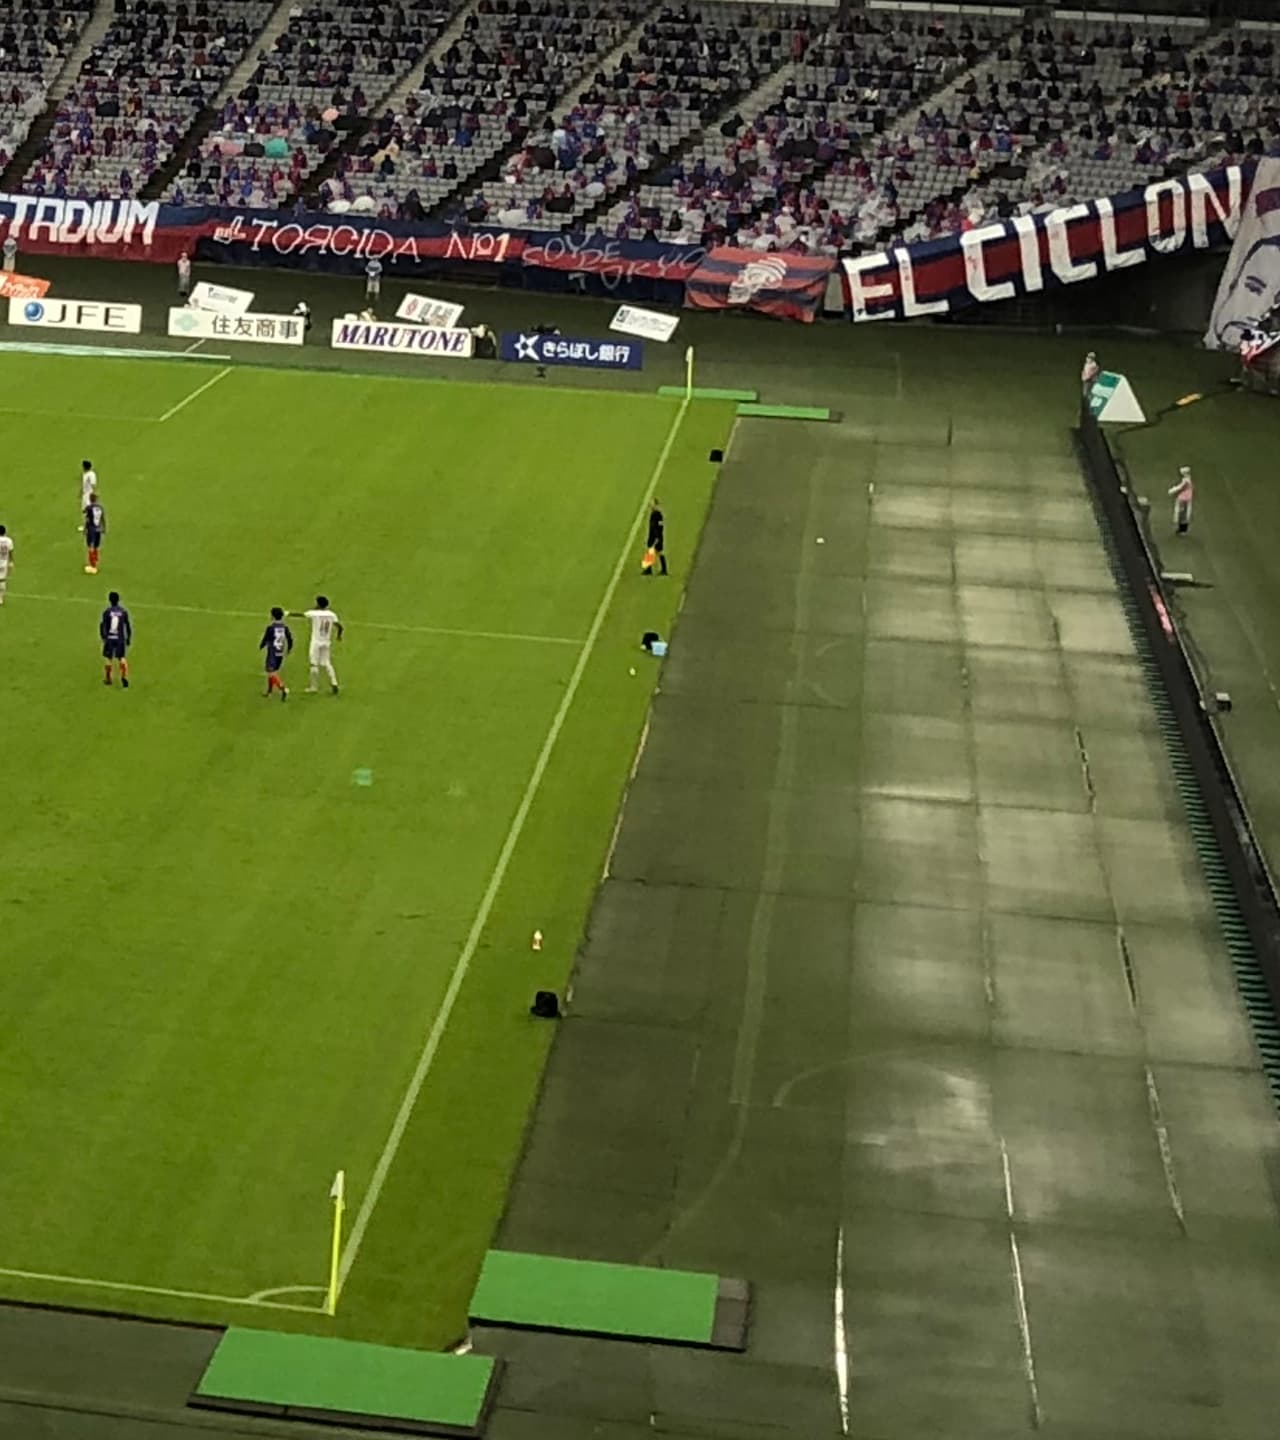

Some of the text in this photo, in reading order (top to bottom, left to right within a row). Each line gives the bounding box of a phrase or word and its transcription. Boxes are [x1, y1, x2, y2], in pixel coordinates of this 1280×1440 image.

[252, 218, 422, 263] TORCIDA
[842, 165, 1241, 322] EL CICLON
[47, 303, 128, 329] JFE
[212, 315, 300, 340] 住友商事
[337, 324, 468, 353] MARUTONE
[542, 341, 631, 364] きらぼし銀行
